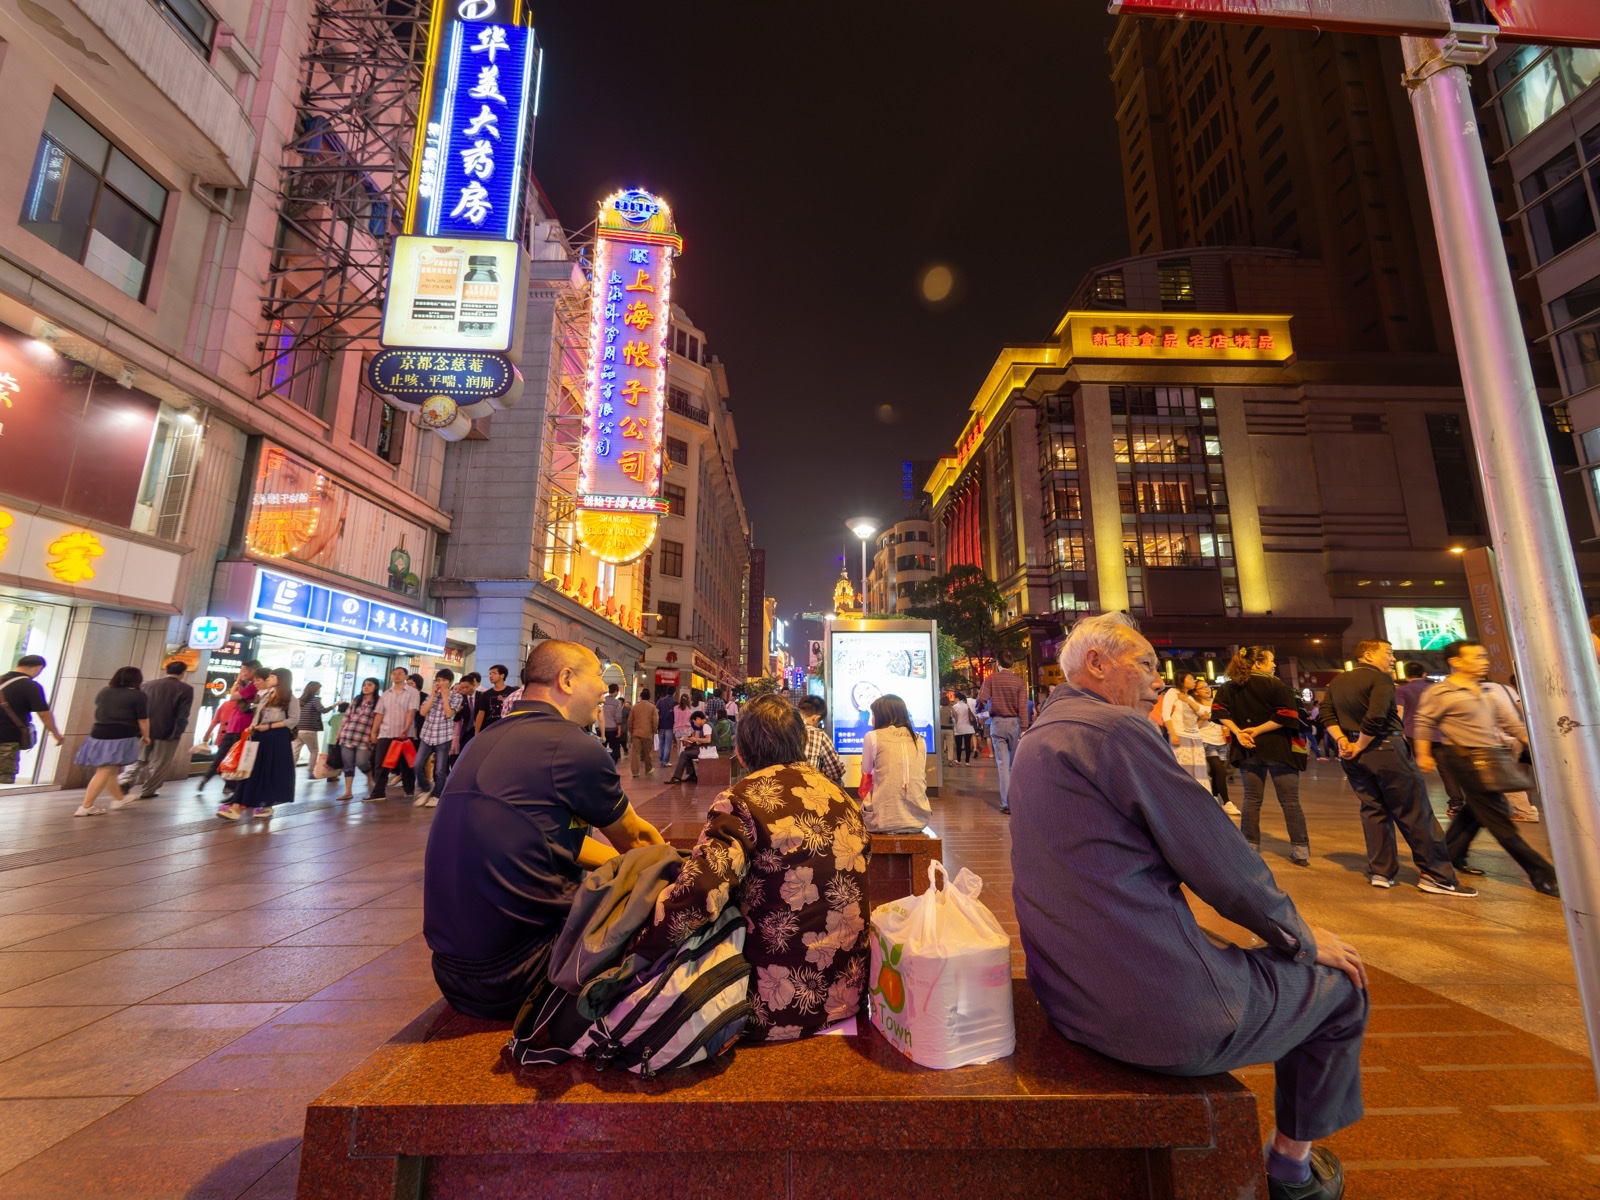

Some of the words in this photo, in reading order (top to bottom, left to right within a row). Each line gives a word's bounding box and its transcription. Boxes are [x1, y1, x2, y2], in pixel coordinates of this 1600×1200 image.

[450, 25, 511, 227] 华美大药房
[618, 269, 656, 483] 上海帐子公司
[599, 514, 632, 524] SHANGHAI
[372, 609, 430, 639] 华美大药房
[879, 1003, 913, 1048] Town
